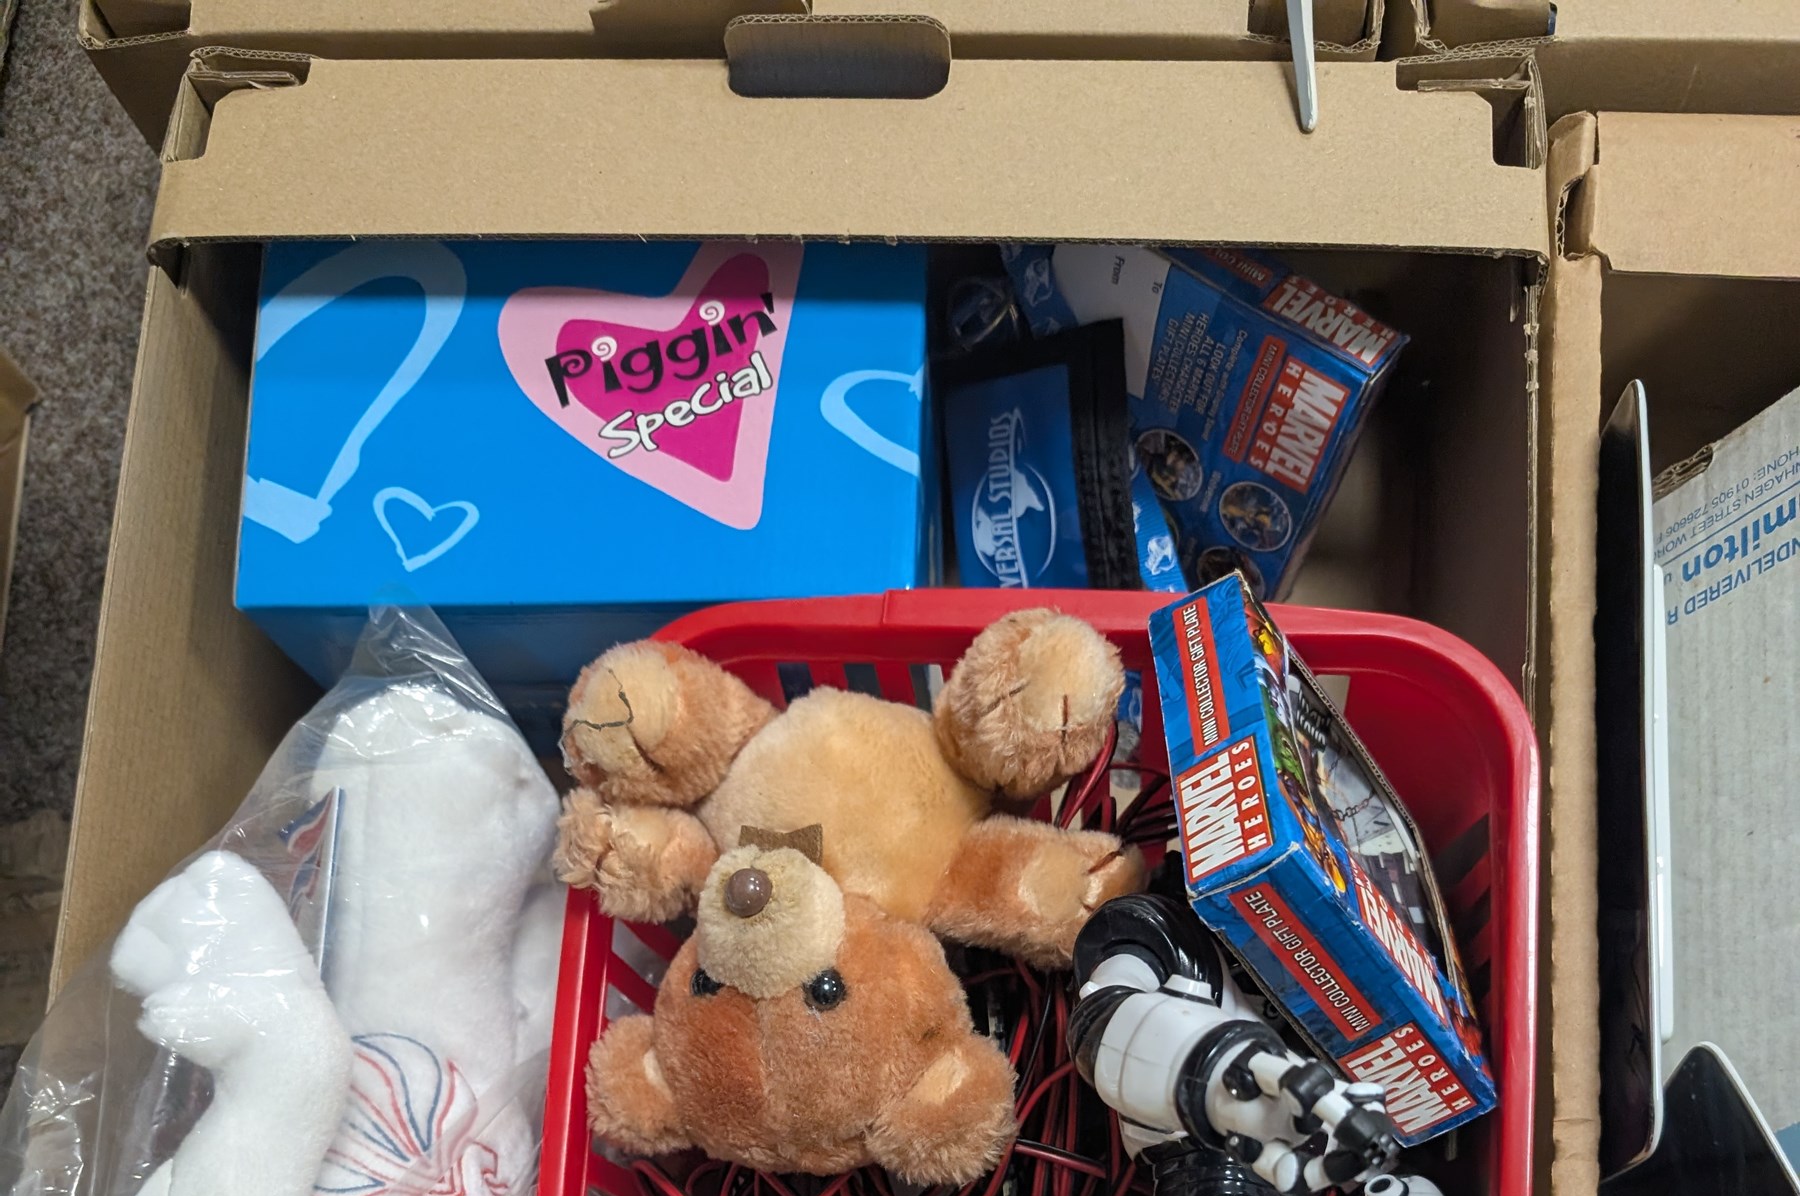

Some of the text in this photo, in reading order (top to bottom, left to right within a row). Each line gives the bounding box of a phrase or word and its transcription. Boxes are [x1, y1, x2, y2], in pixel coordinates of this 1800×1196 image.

[1111, 255, 1125, 286] From
[1151, 281, 1163, 294] To
[1164, 319, 1179, 344] GIFT
[1180, 312, 1195, 340] MINI
[1272, 283, 1388, 364] MARVEL
[1288, 275, 1394, 339] HEROES
[544, 292, 777, 409] Piggin'
[1169, 312, 1210, 414] HEROES CHARACTER
[1200, 335, 1215, 356] ALL
[1209, 342, 1226, 372] LOOK
[1226, 329, 1248, 372] Complete
[1264, 343, 1277, 368] MINI
[598, 350, 773, 459] Special
[1184, 368, 1203, 406] MARVEL
[1195, 394, 1208, 416] FOR
[1201, 373, 1214, 393] OUT
[1245, 366, 1268, 416] COLLECTOR
[1250, 361, 1303, 469] HEROES
[1264, 370, 1346, 485] MARVEL
[988, 411, 1013, 503] STUDIOS
[1690, 498, 1742, 539] STREET
[1711, 478, 1750, 509] 01905
[1665, 503, 1708, 538] 726606
[1681, 496, 1800, 583] milton
[1182, 604, 1219, 746] MINI COLLECTOR GIFT PLATE
[1180, 751, 1246, 879] MARVEL
[1231, 741, 1268, 851] HEROES
[1244, 890, 1371, 1032] MINI COLLECTOR GIFT PLATE
[1394, 1026, 1472, 1111] HEROES
